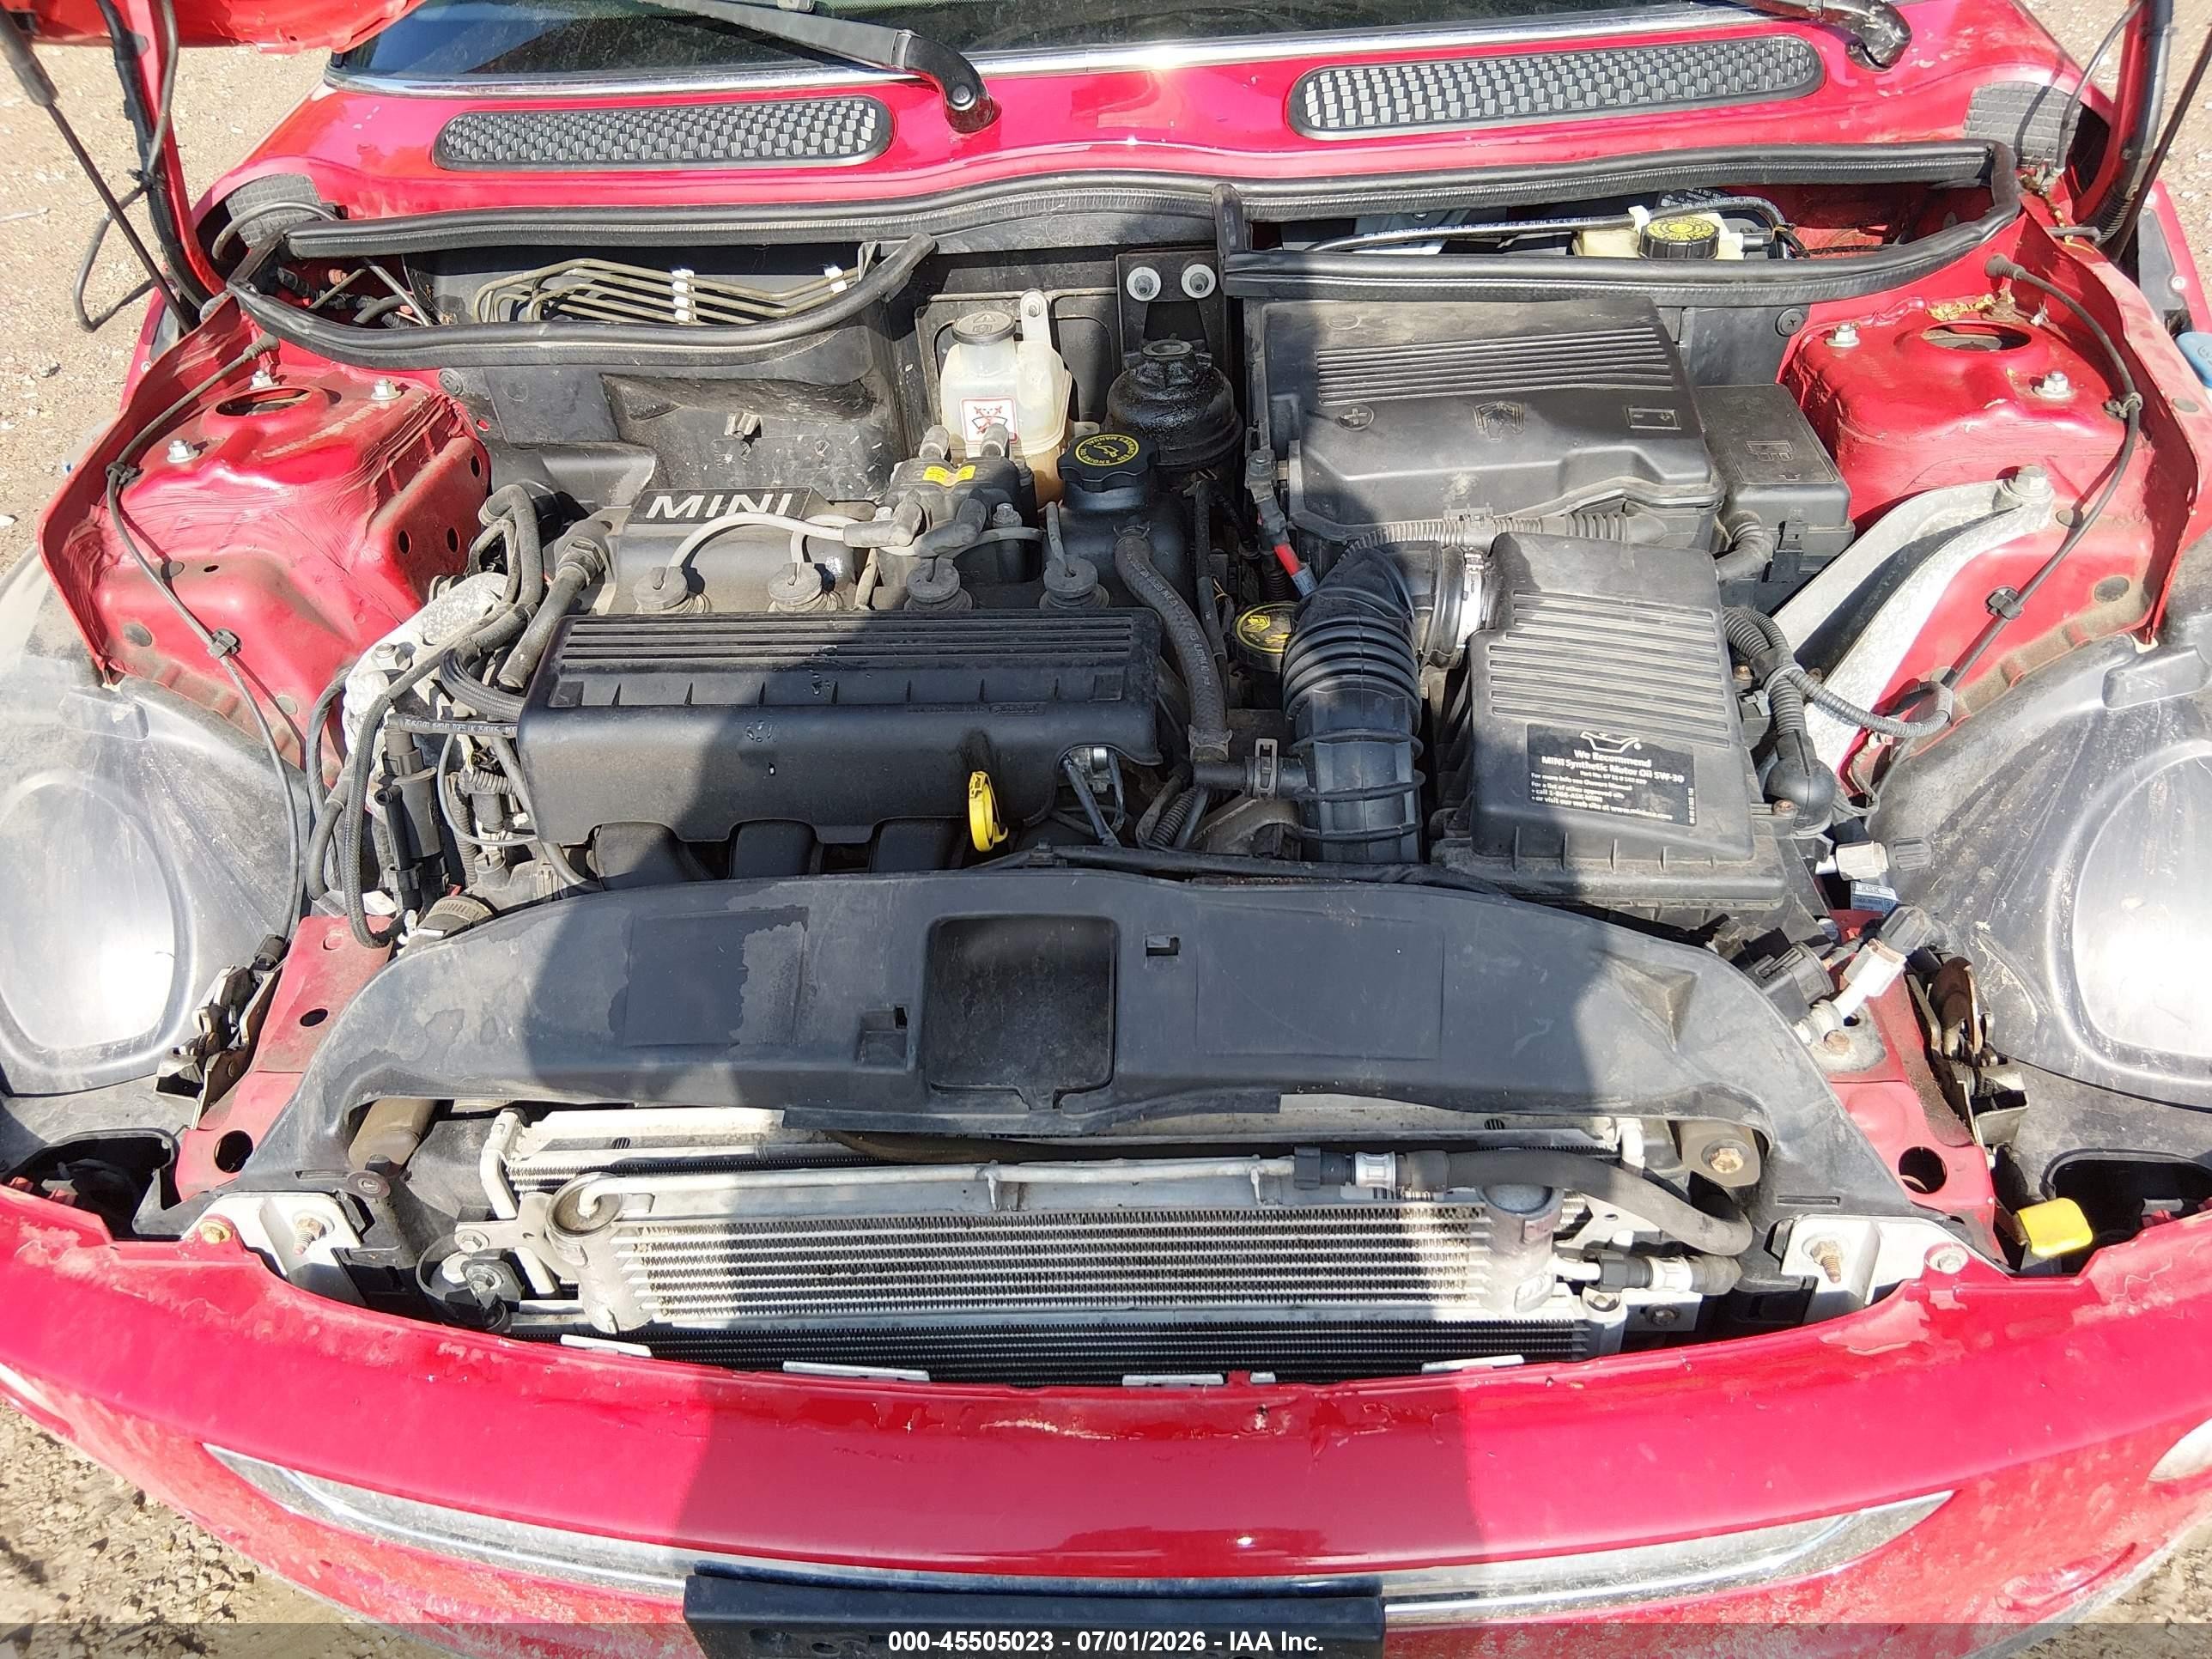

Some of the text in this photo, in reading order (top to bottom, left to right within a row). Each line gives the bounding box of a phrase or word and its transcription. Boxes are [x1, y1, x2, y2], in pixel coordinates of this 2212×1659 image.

[646, 493, 793, 519] MINI
[1541, 756, 1685, 784] MINI Synthetic Motor Oil 5W-30
[1574, 750, 1652, 768] We Recommend
[1572, 800, 1589, 809] web
